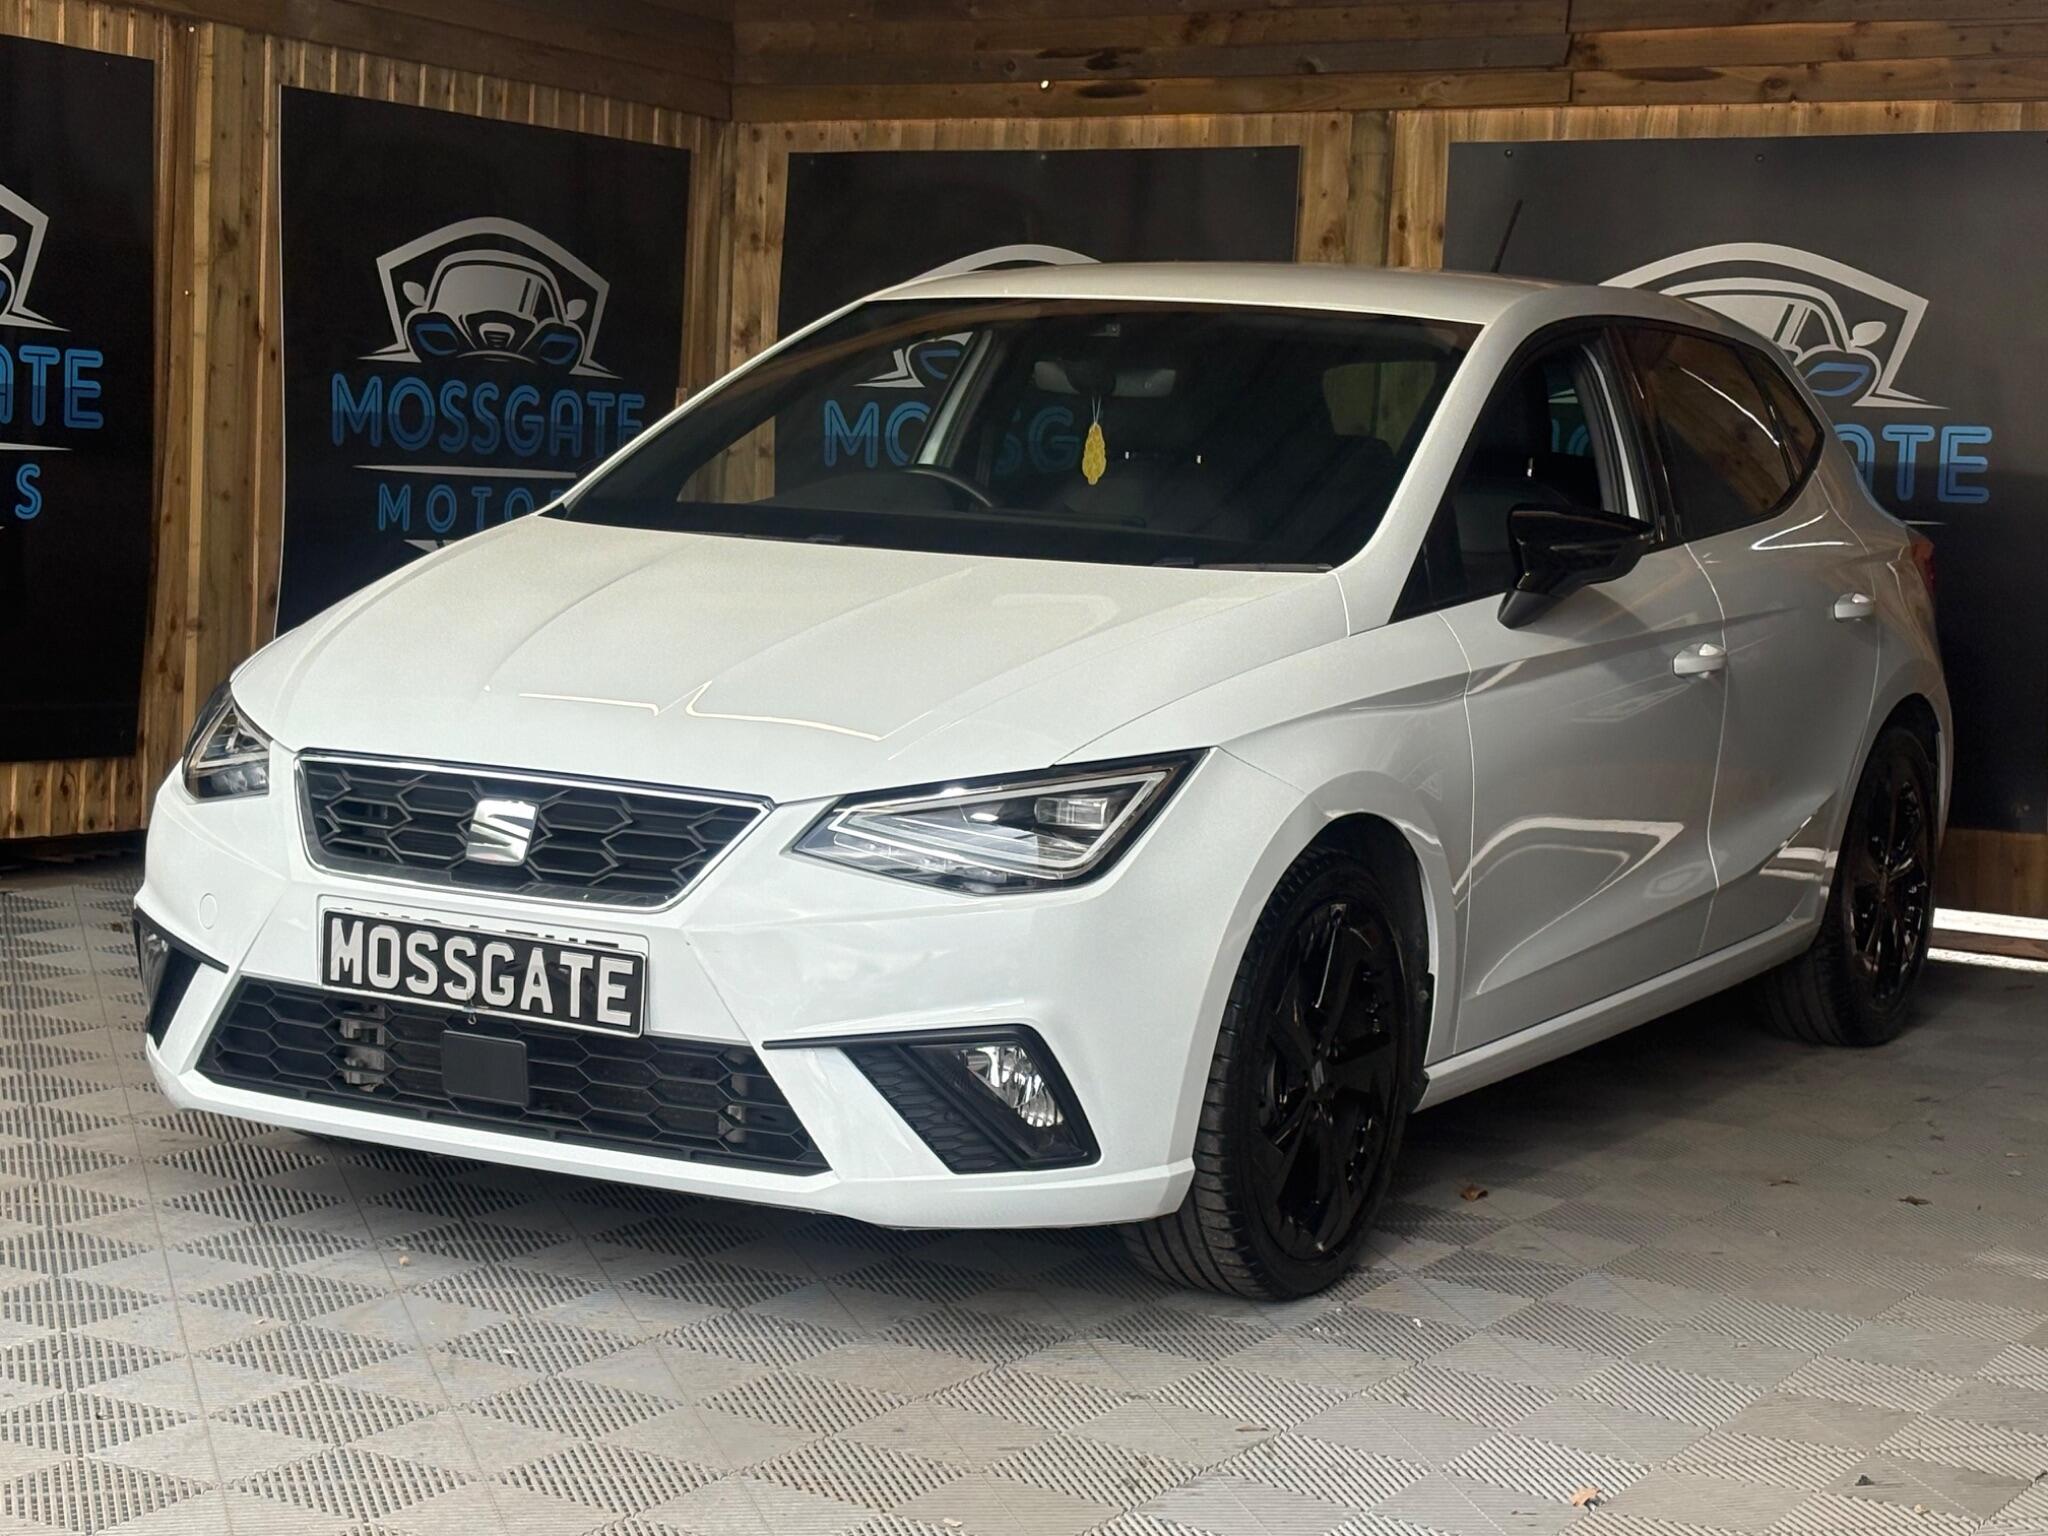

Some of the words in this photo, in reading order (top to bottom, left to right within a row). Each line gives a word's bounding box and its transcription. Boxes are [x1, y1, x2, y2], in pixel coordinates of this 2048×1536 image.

[331, 372, 646, 458] MOSSGATE
[378, 482, 566, 534] MOTO
[329, 916, 635, 1027] MOSSGATE
